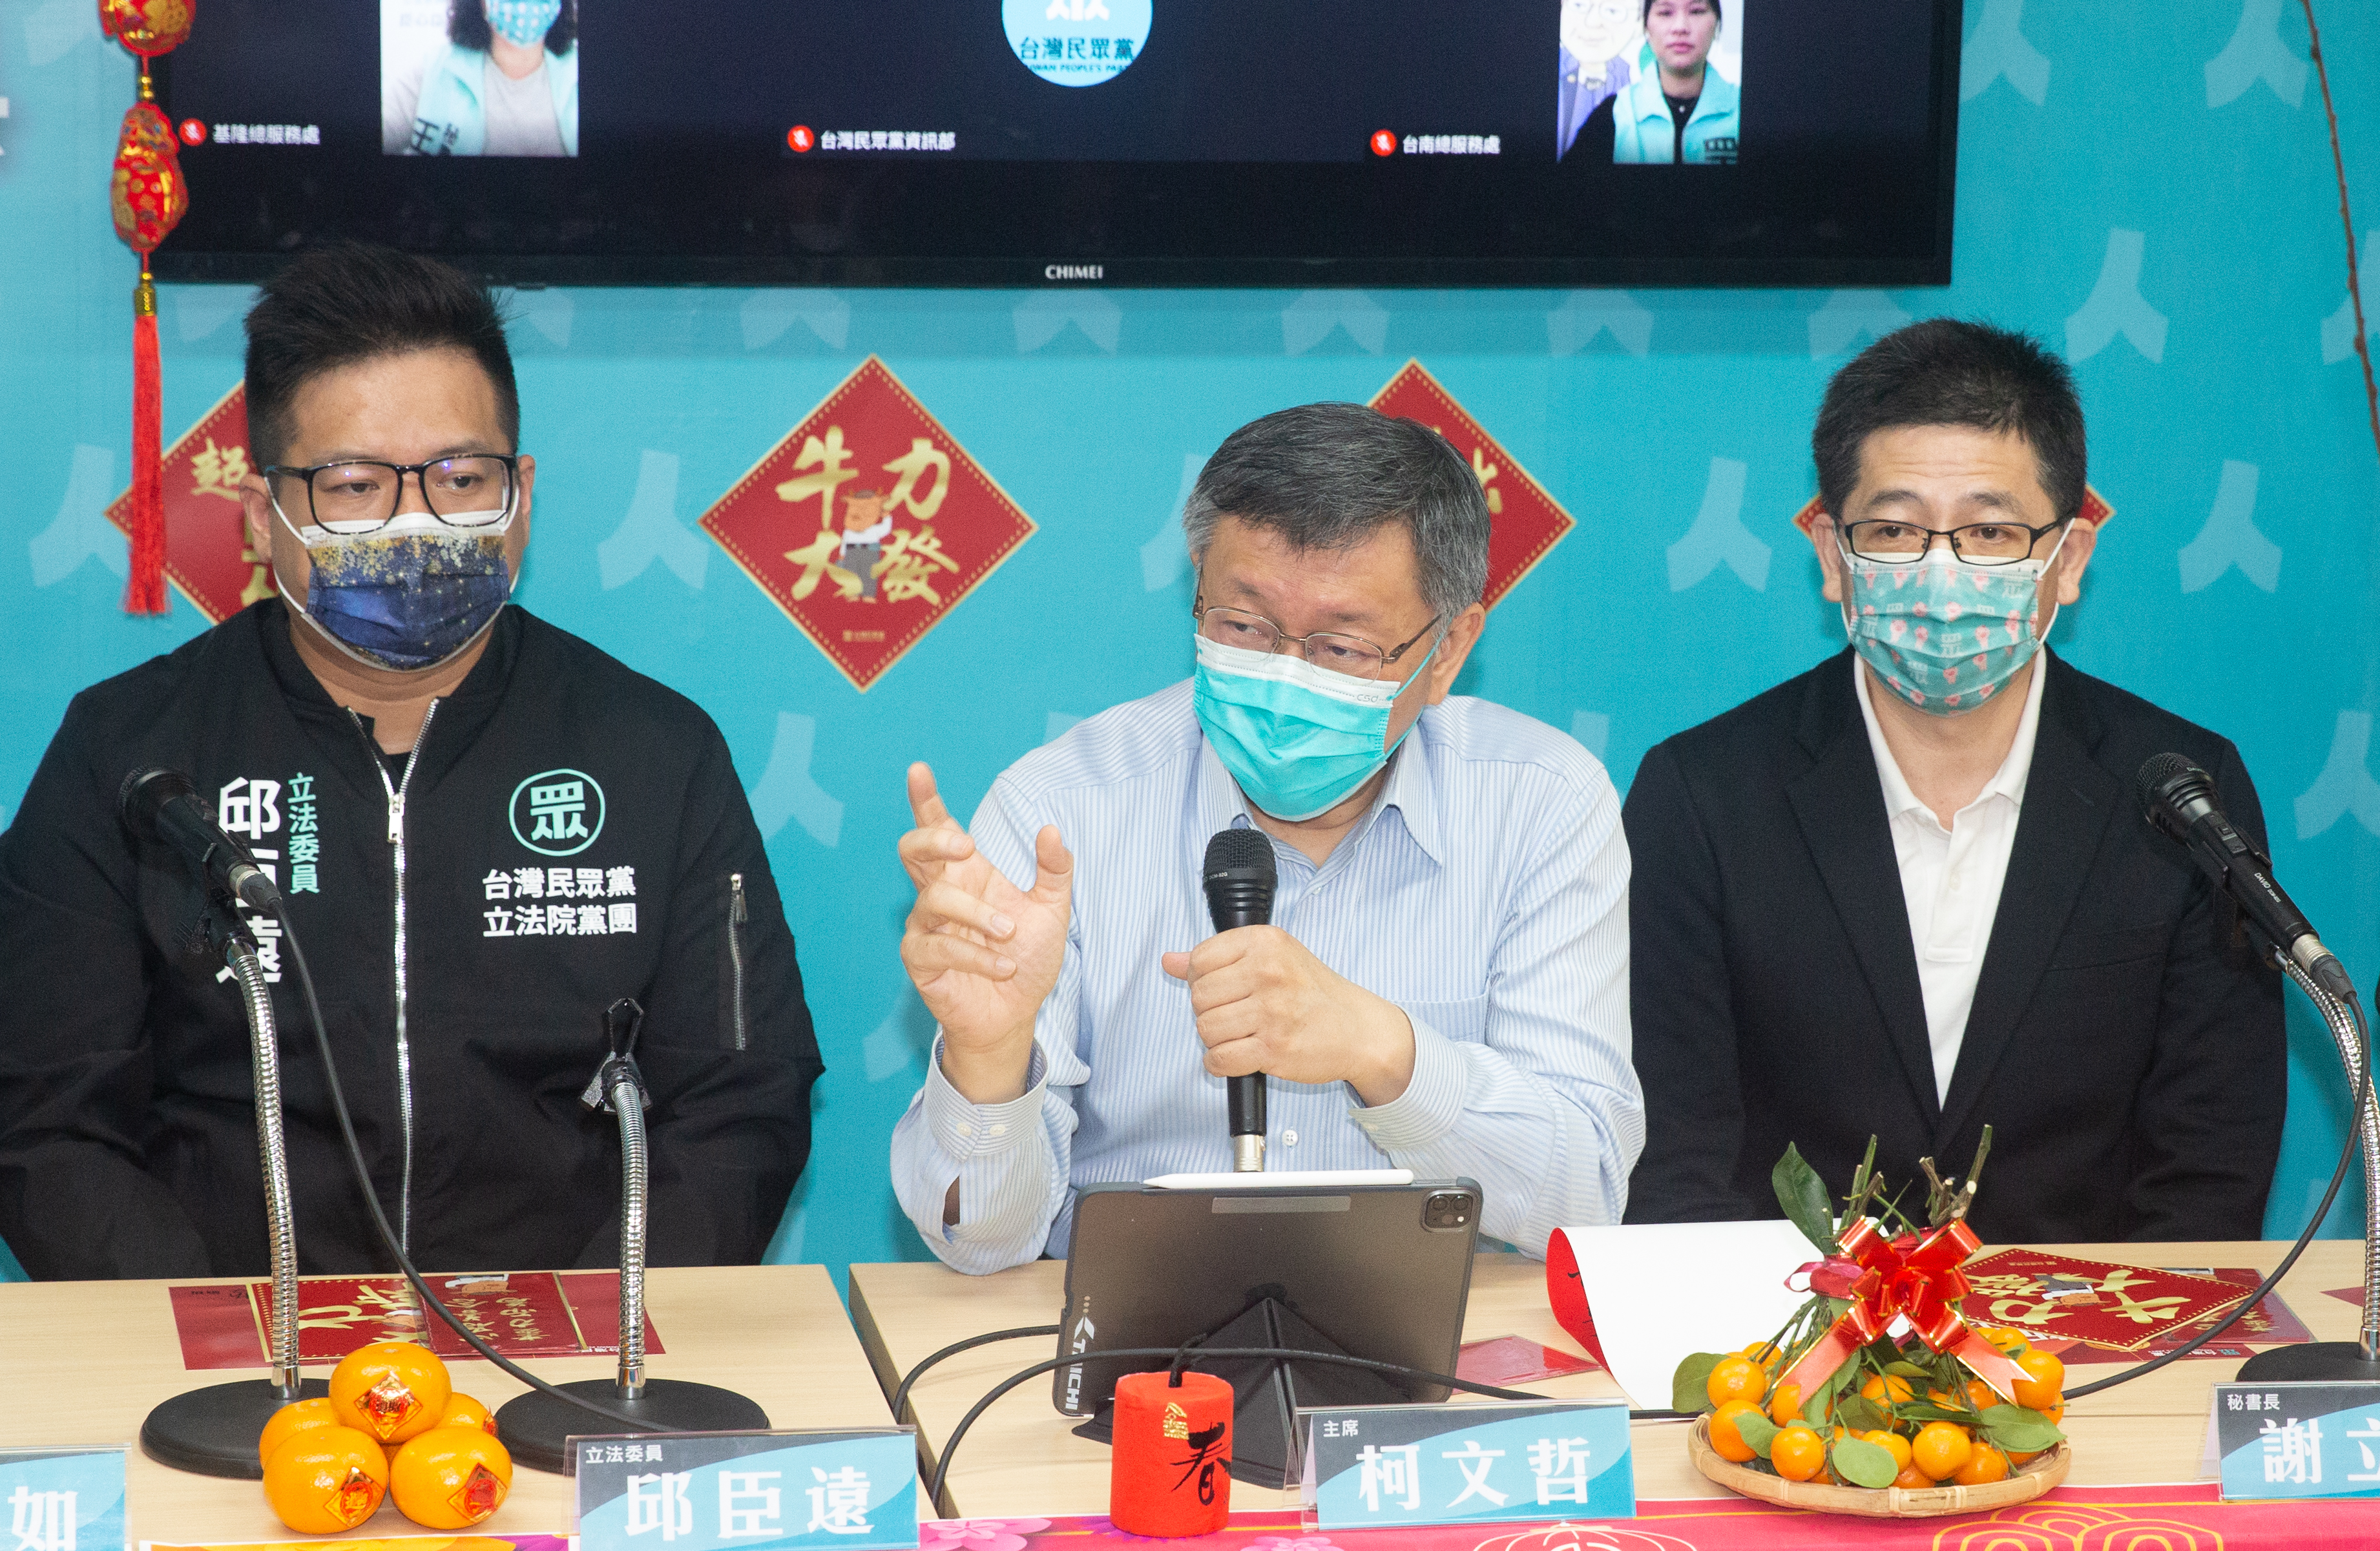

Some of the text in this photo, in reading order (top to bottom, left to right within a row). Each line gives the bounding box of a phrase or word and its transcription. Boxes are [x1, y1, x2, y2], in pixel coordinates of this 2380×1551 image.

[1019, 36, 1134, 61] 台灣民眾黨
[213, 123, 320, 145] 基隆總服務處
[820, 130, 956, 151] 台灣民眾黨資訊部
[1403, 134, 1501, 154] 台南總服務處
[1045, 265, 1103, 280] CHIMEI
[775, 424, 951, 531] 牛力
[783, 525, 961, 605] 大發
[287, 772, 320, 895] 立法委員
[482, 865, 636, 900] 台灣民眾黨
[2254, 872, 2271, 890] DAVID
[483, 902, 638, 937] 立法院黨團
[1065, 1338, 1086, 1410] TICHI
[2227, 1393, 2281, 1411] 秘書長
[1323, 1419, 1359, 1438] 主席
[585, 1444, 663, 1464] 立法委員
[1355, 1436, 1591, 1512] 柯文哲
[624, 1465, 875, 1542] 邱臣遠
